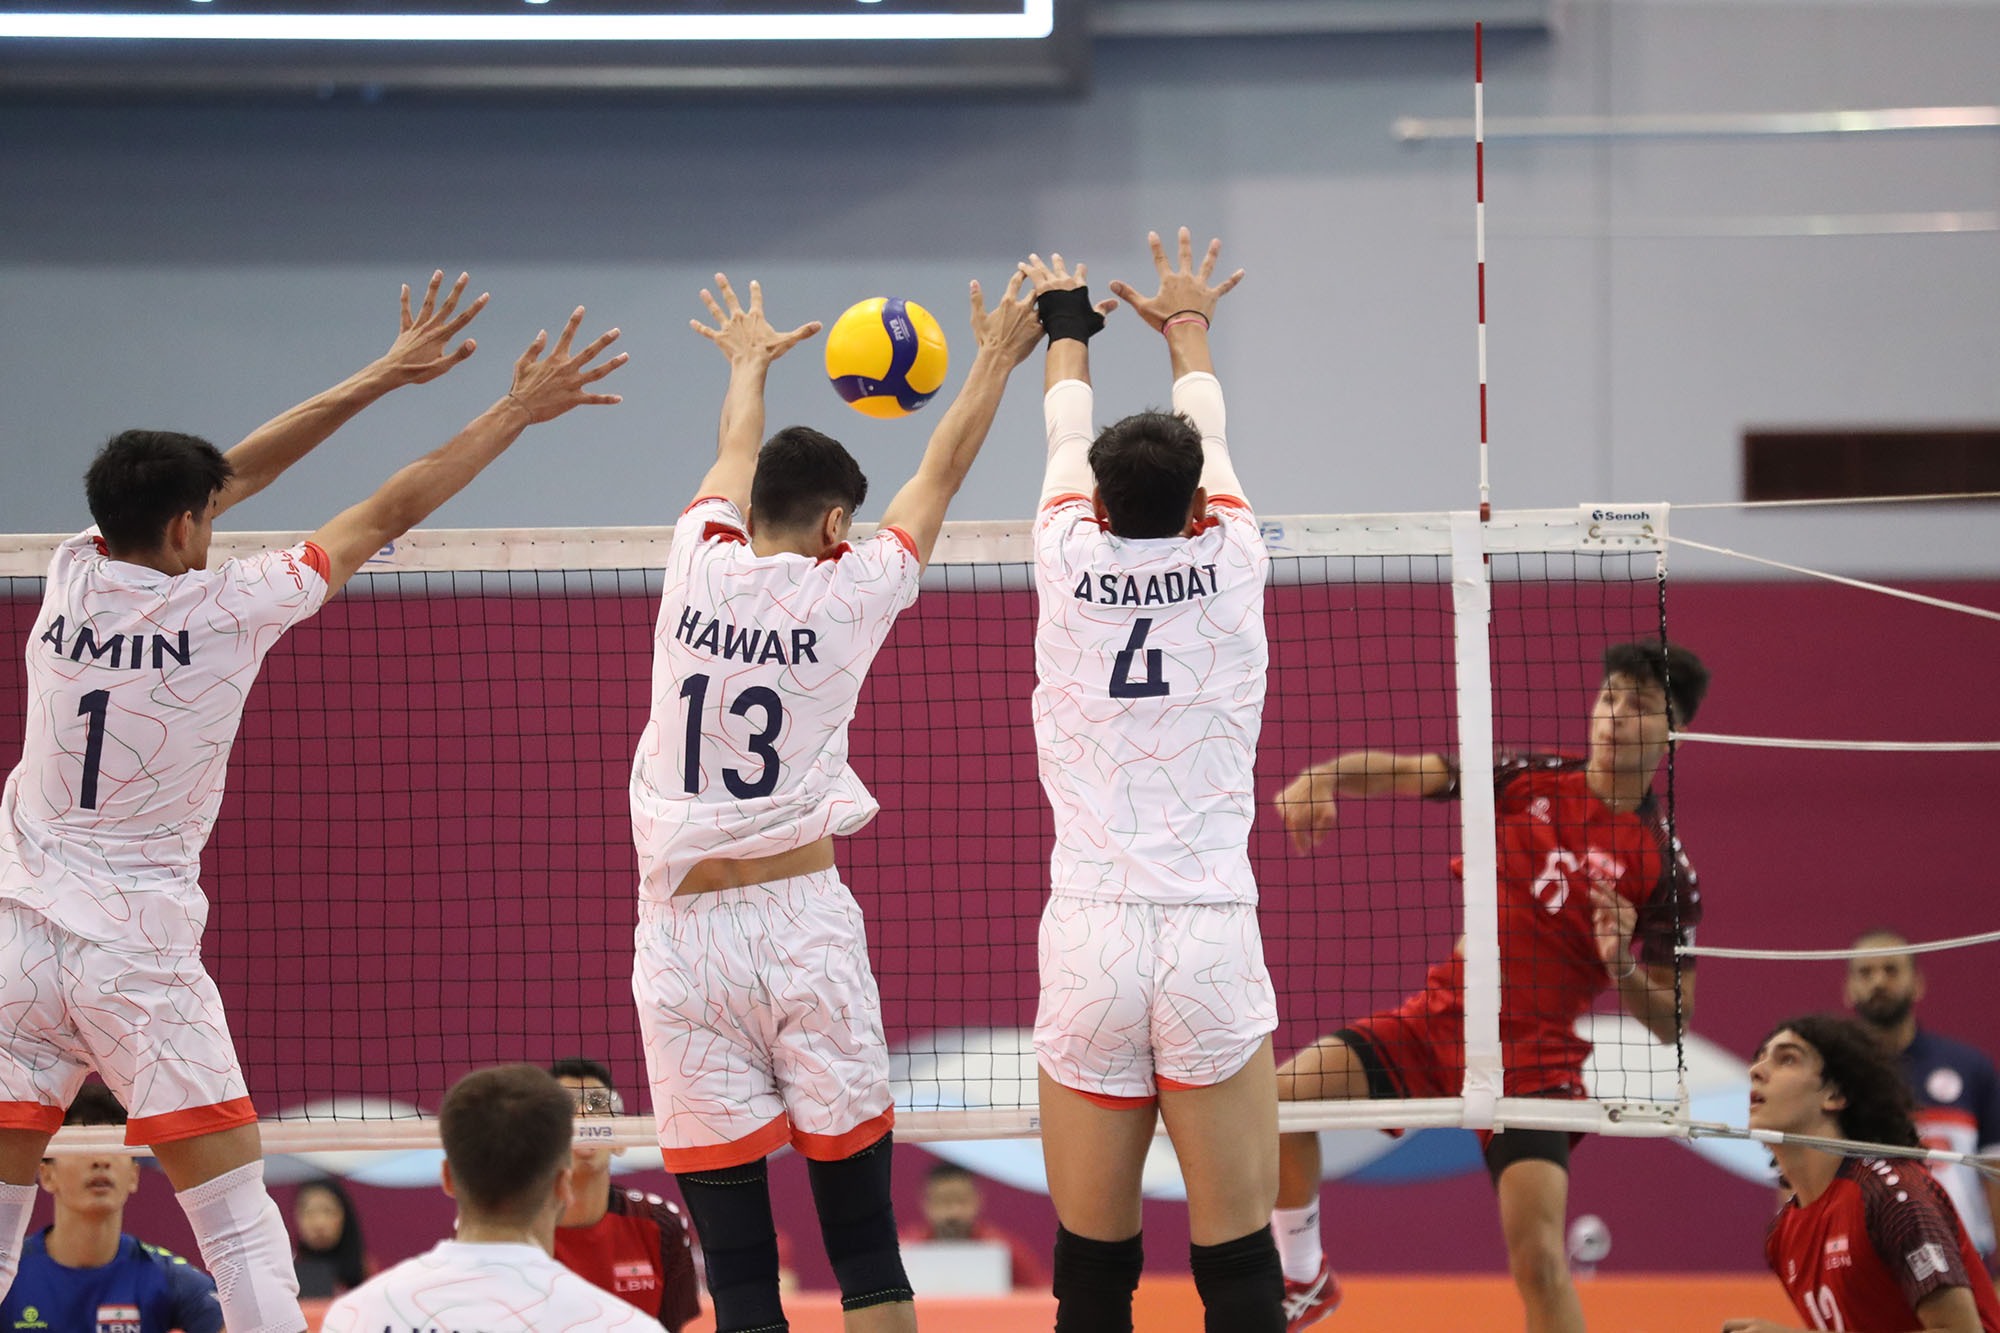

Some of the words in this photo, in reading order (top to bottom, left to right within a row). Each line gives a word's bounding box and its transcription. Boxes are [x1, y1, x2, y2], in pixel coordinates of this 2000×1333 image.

[1605, 510, 1650, 521] Senoh
[41, 614, 190, 669] AMIN
[675, 605, 819, 665] HAWAR
[1109, 618, 1170, 699] 4
[77, 689, 110, 810] 1
[679, 673, 784, 800] 13
[579, 1126, 613, 1137] FIVB
[614, 1279, 655, 1292] LBN
[96, 1324, 141, 1333] LBN
